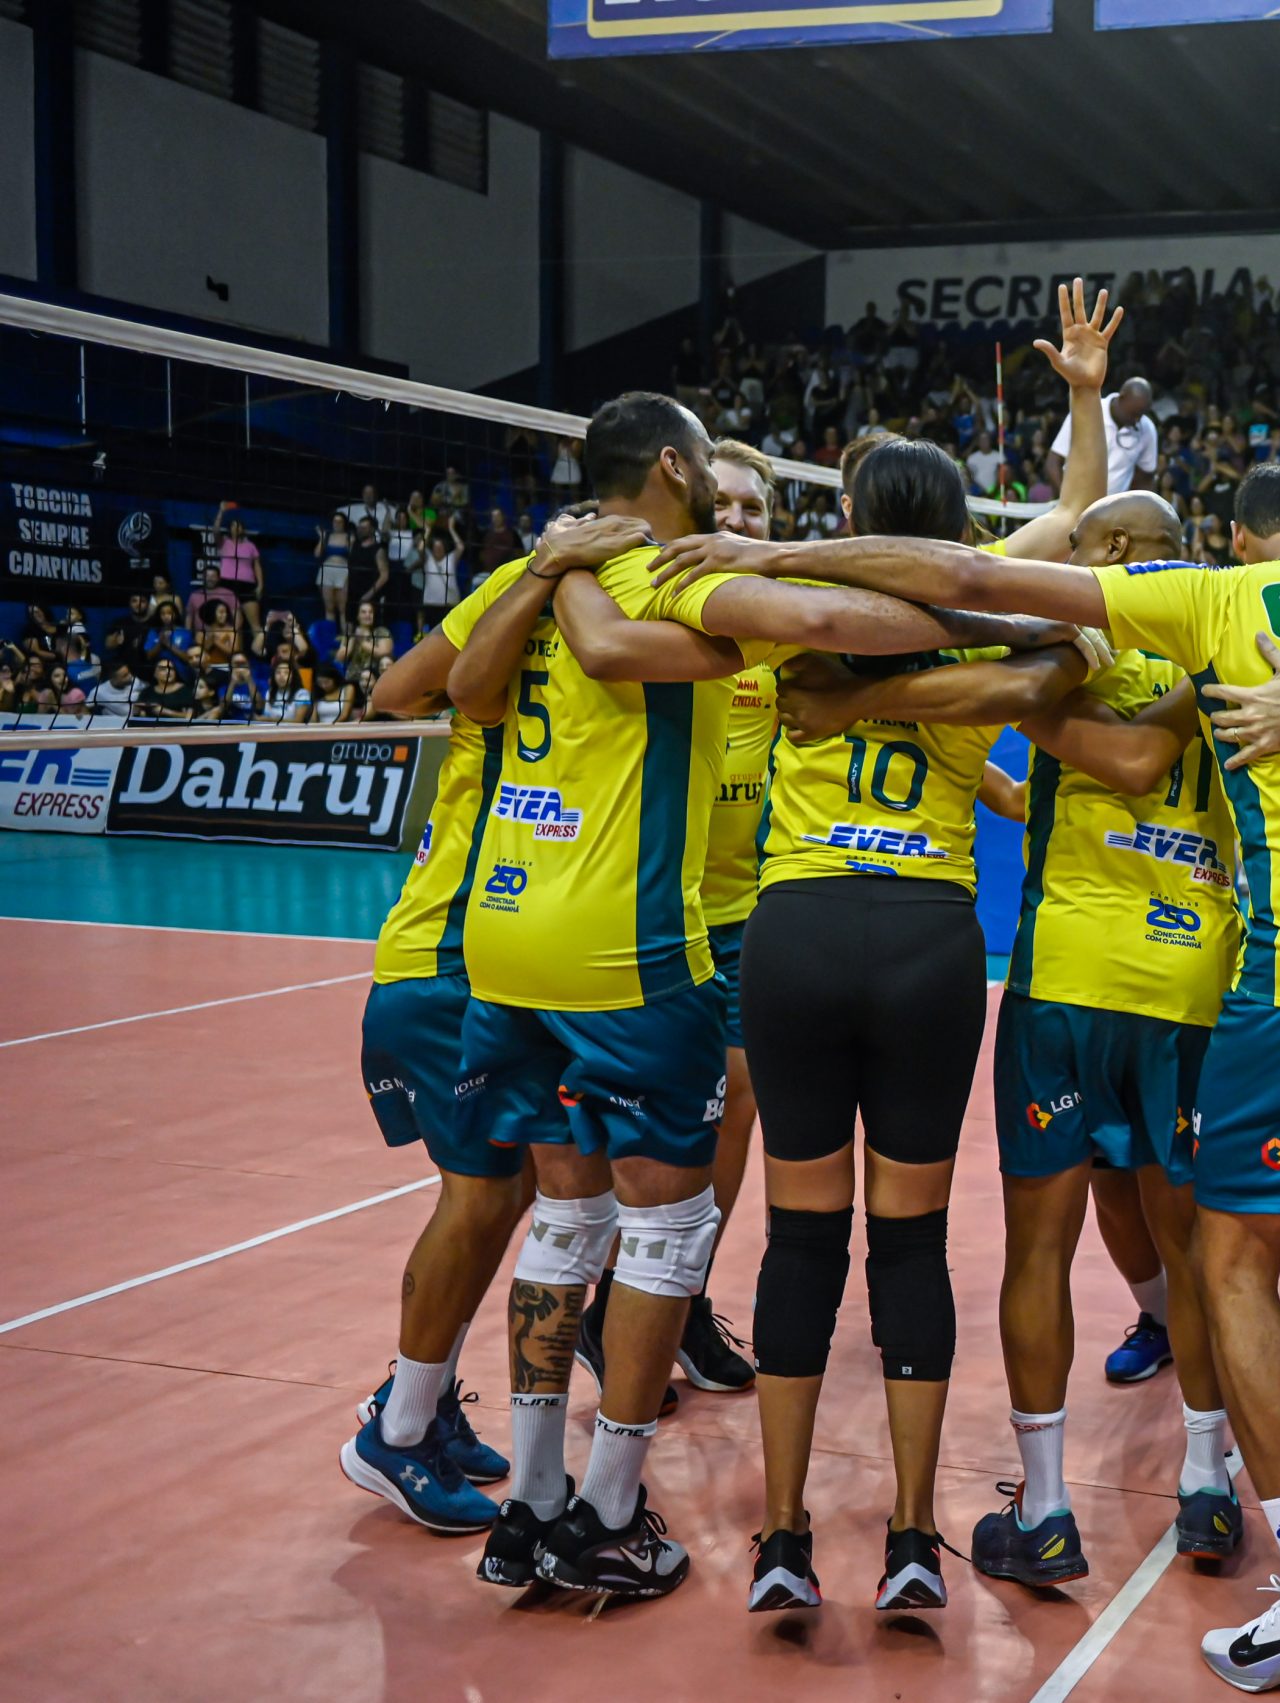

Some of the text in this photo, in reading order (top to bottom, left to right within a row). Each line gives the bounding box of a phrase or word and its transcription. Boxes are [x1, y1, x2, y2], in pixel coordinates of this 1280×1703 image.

[10, 482, 93, 518] TORCIDA
[18, 517, 90, 551] SEMPRE
[8, 550, 104, 584] CAMPINAS
[517, 669, 552, 763] 5
[732, 694, 763, 709] ENDAS
[331, 741, 392, 763] grupo
[119, 742, 404, 836] Dahruj
[845, 735, 929, 812] 10
[14, 792, 105, 820] EXPRESS
[535, 823, 578, 838] EXPRESS
[826, 825, 929, 856] EVER
[1132, 822, 1219, 869] EVER
[1146, 898, 1201, 932] 250
[1145, 934, 1161, 943] COM
[1153, 929, 1196, 941] CONECTADA
